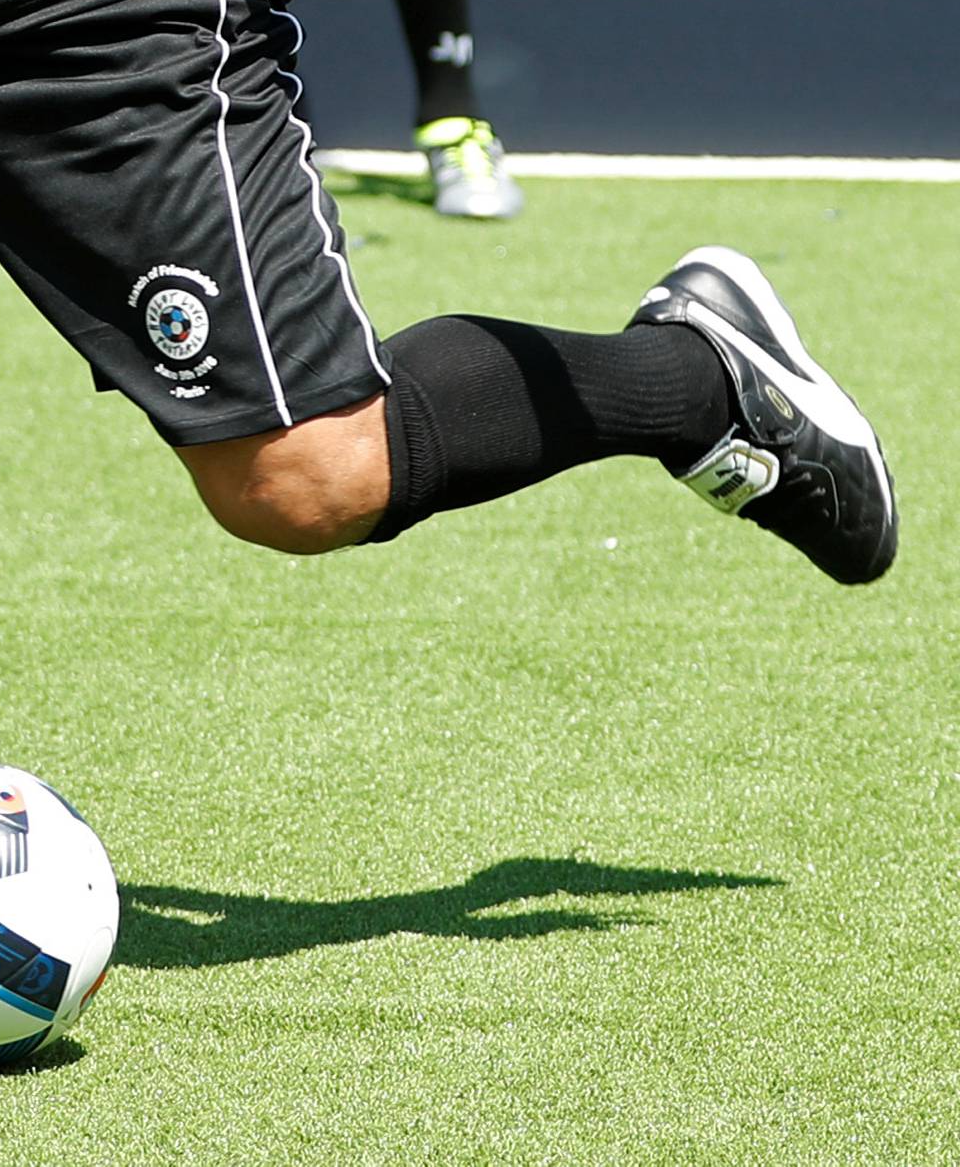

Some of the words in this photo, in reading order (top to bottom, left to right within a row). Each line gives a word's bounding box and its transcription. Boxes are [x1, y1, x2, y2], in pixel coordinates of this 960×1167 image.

[128, 275, 150, 308] Match
[148, 266, 159, 281] of
[158, 264, 220, 297] Friendship
